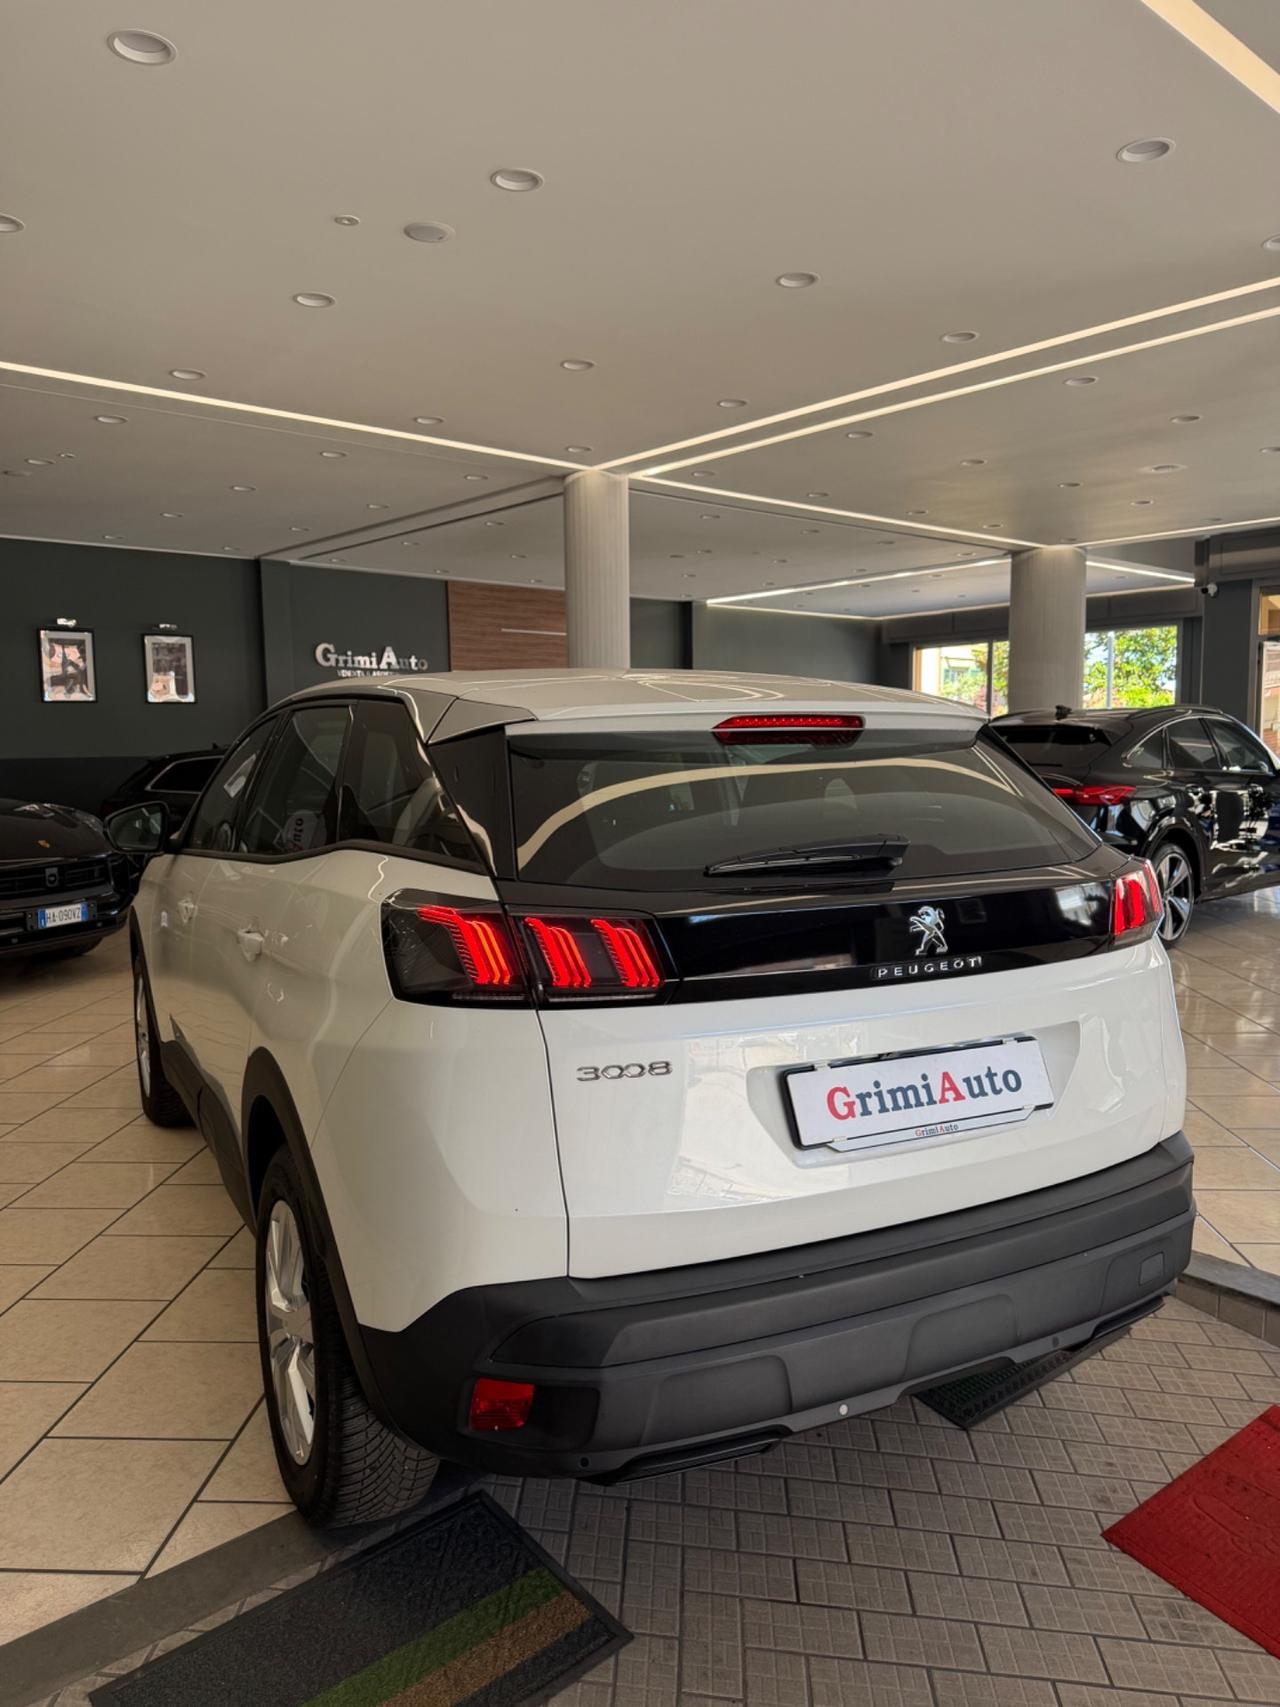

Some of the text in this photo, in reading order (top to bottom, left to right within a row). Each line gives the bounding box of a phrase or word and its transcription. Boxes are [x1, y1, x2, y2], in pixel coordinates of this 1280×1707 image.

[877, 955, 981, 978] PEUGEOT
[576, 1060, 673, 1082] 3008
[827, 1066, 1022, 1121] GrimiAuto
[914, 1123, 959, 1137] GrimiAuto
